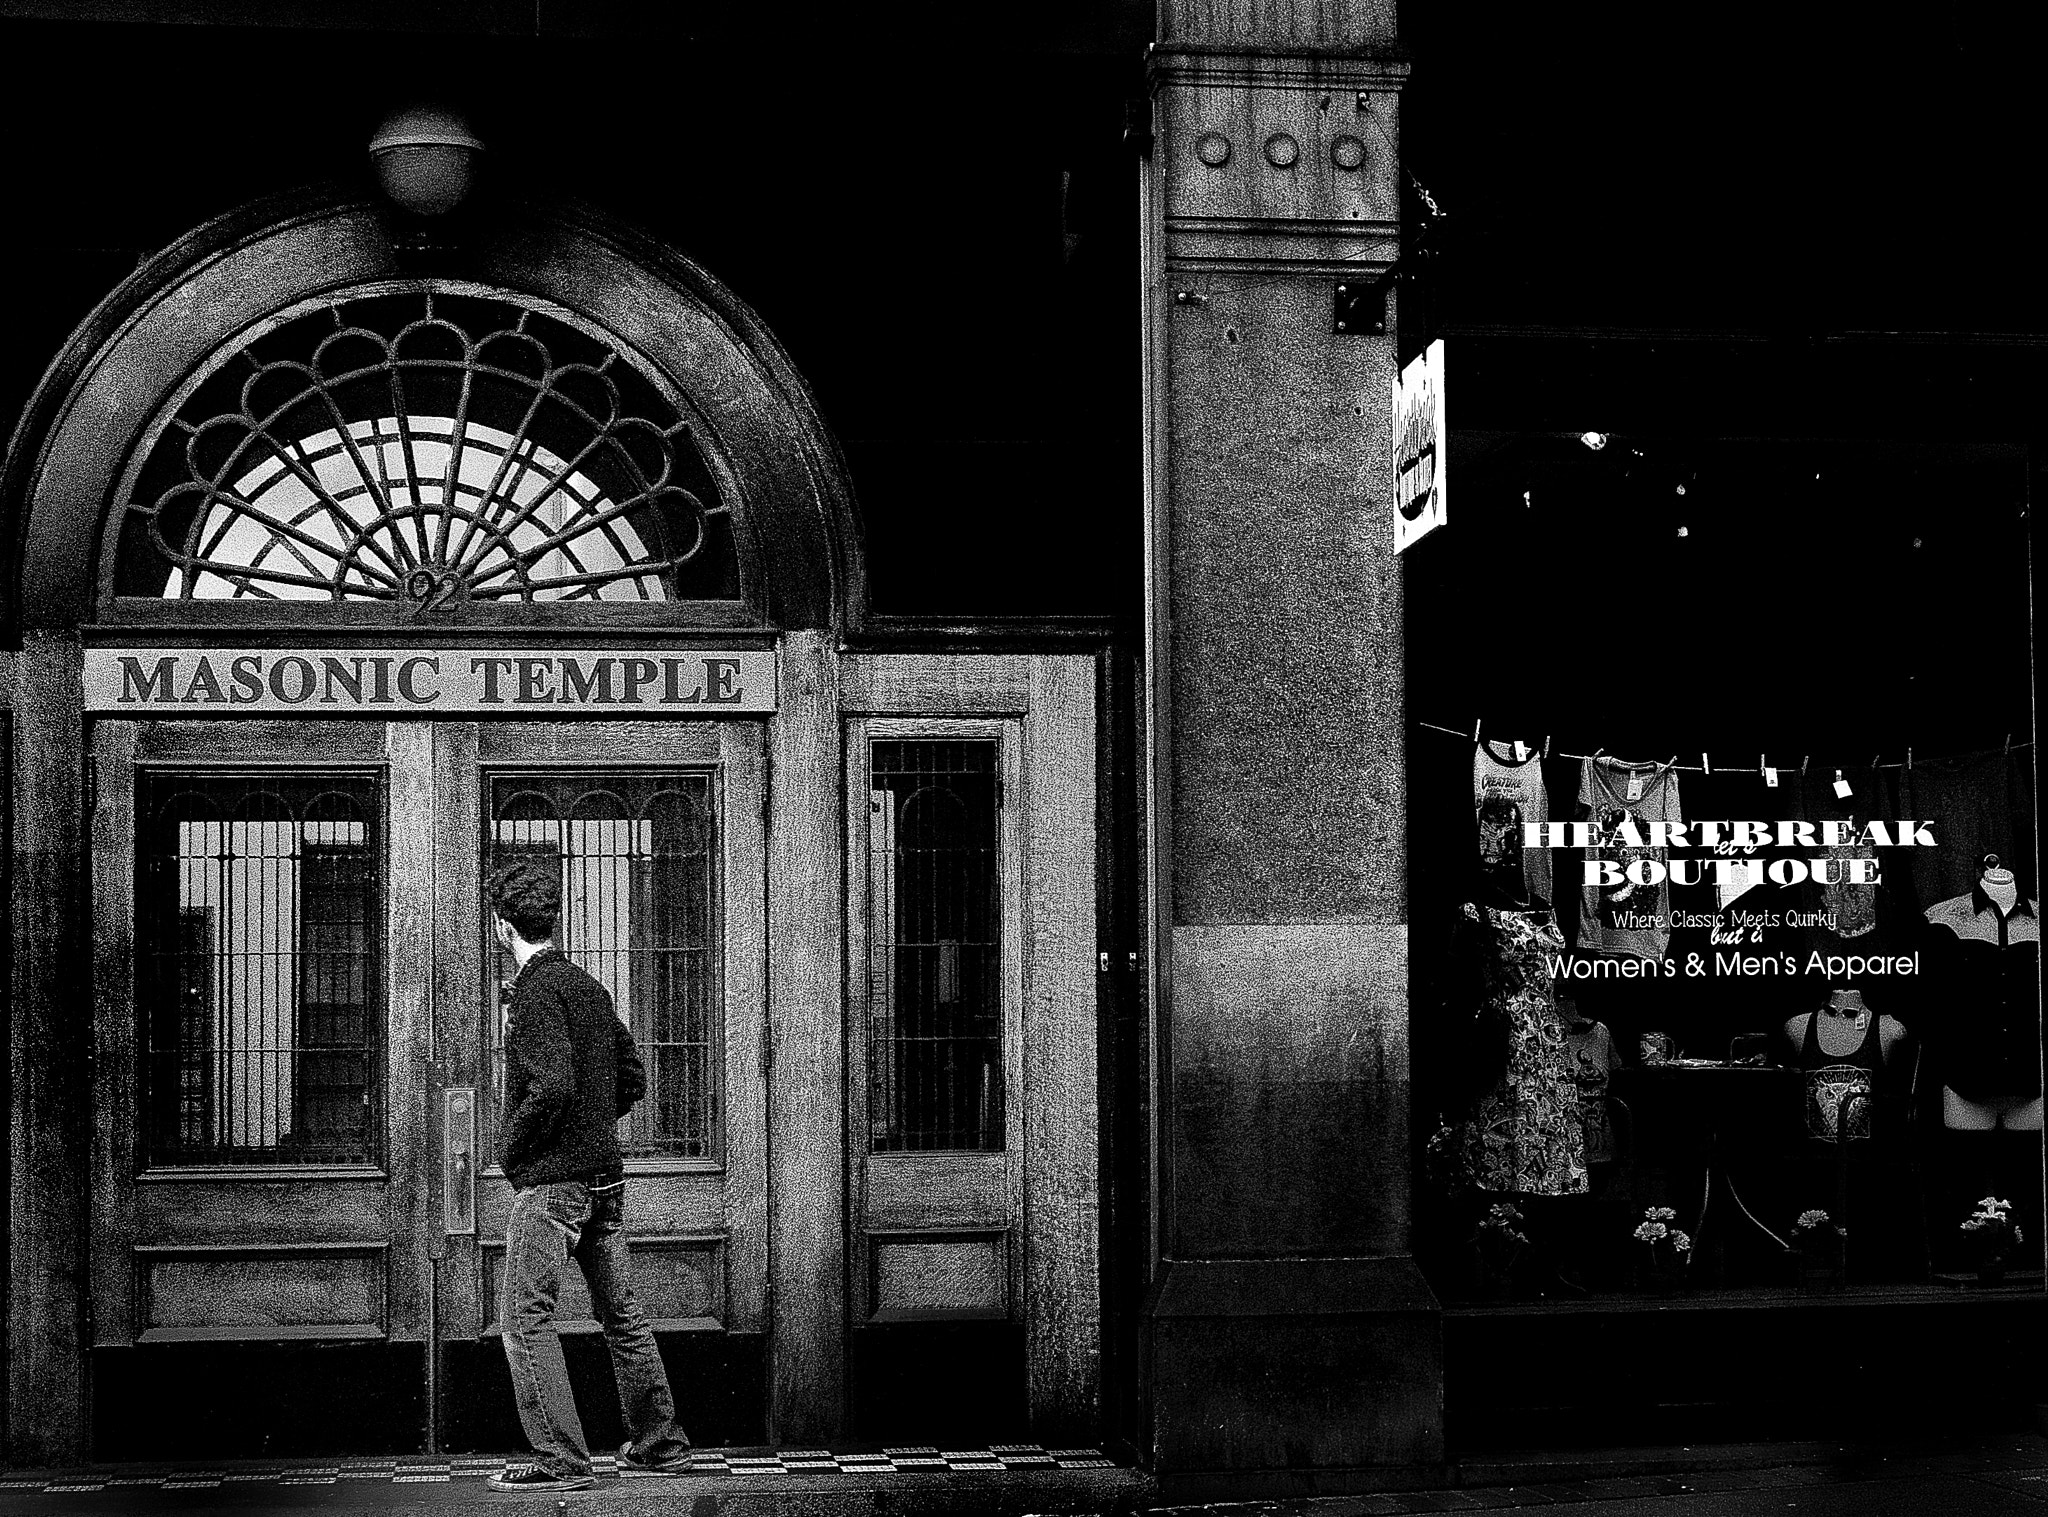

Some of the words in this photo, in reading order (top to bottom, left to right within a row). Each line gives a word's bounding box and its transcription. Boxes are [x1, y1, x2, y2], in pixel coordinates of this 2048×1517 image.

[405, 570, 461, 617] 92
[117, 655, 441, 704] MASONIC
[470, 655, 745, 704] TEMPLE
[1520, 820, 1939, 848] HEARTBREAK
[1581, 858, 1882, 889] BOUTIQUE
[1611, 910, 1665, 929] Where
[1670, 909, 1725, 928] Classic
[1731, 909, 1780, 928] Meets
[1785, 909, 1837, 930] Quirky
[1710, 924, 1744, 946] but
[1545, 953, 1676, 979] Women's
[1685, 952, 1706, 977] &
[1715, 951, 1797, 977] Men's
[1804, 951, 1919, 980] Apparel
